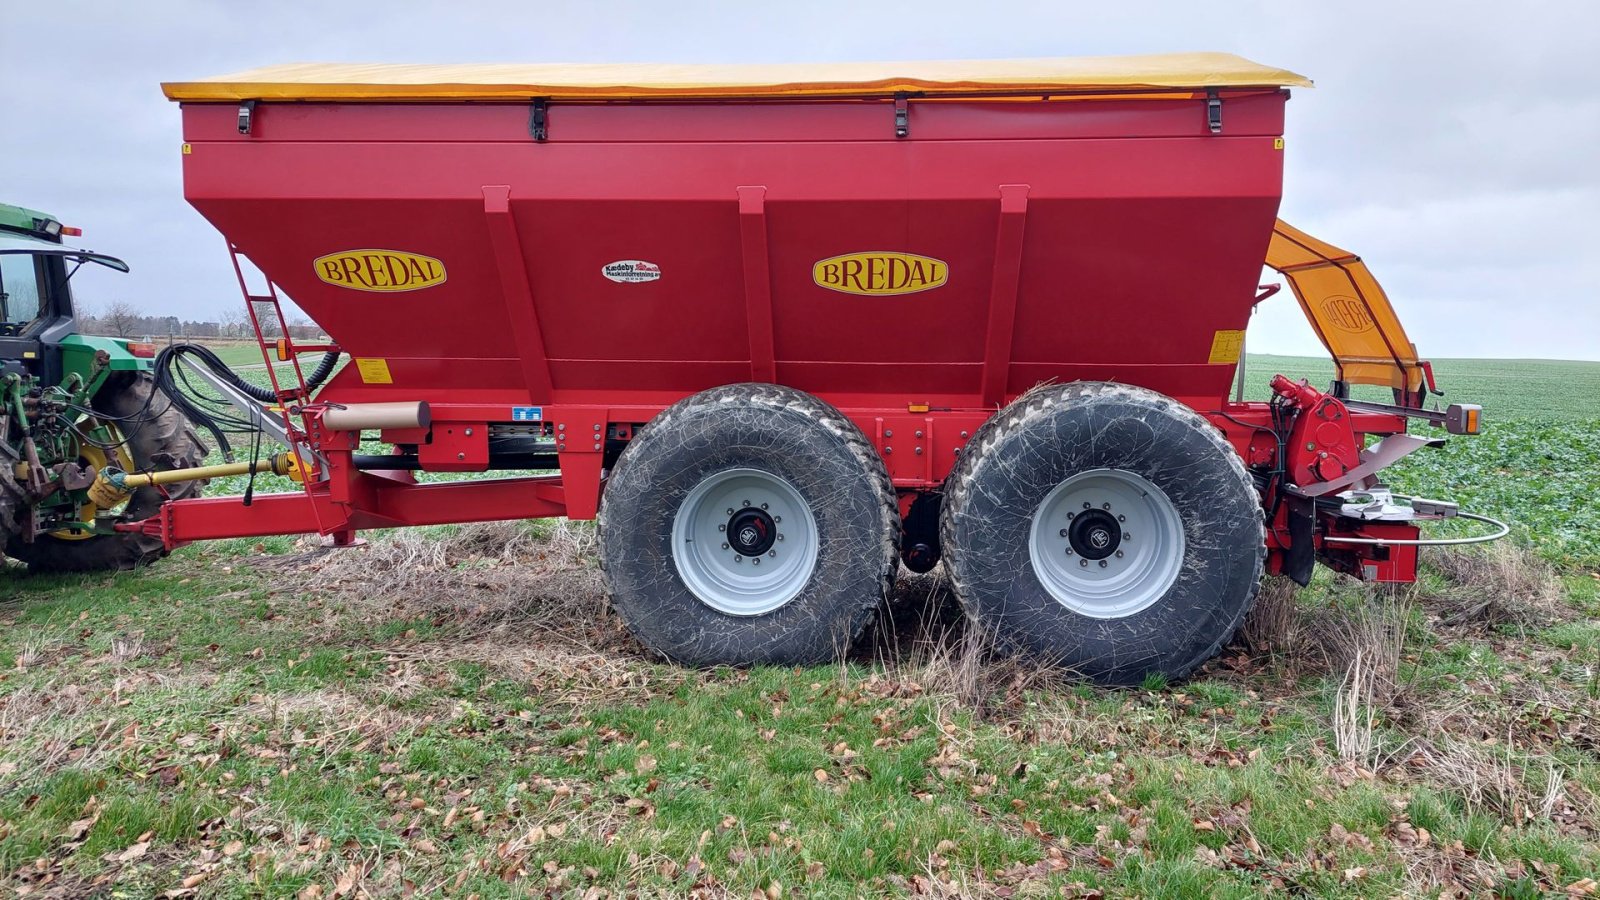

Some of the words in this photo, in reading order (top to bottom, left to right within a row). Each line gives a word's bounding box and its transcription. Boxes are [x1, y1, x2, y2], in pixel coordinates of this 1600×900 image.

[323, 254, 441, 288] BREDAL
[605, 263, 634, 272] Kædeby
[823, 257, 943, 291] BREDAL
